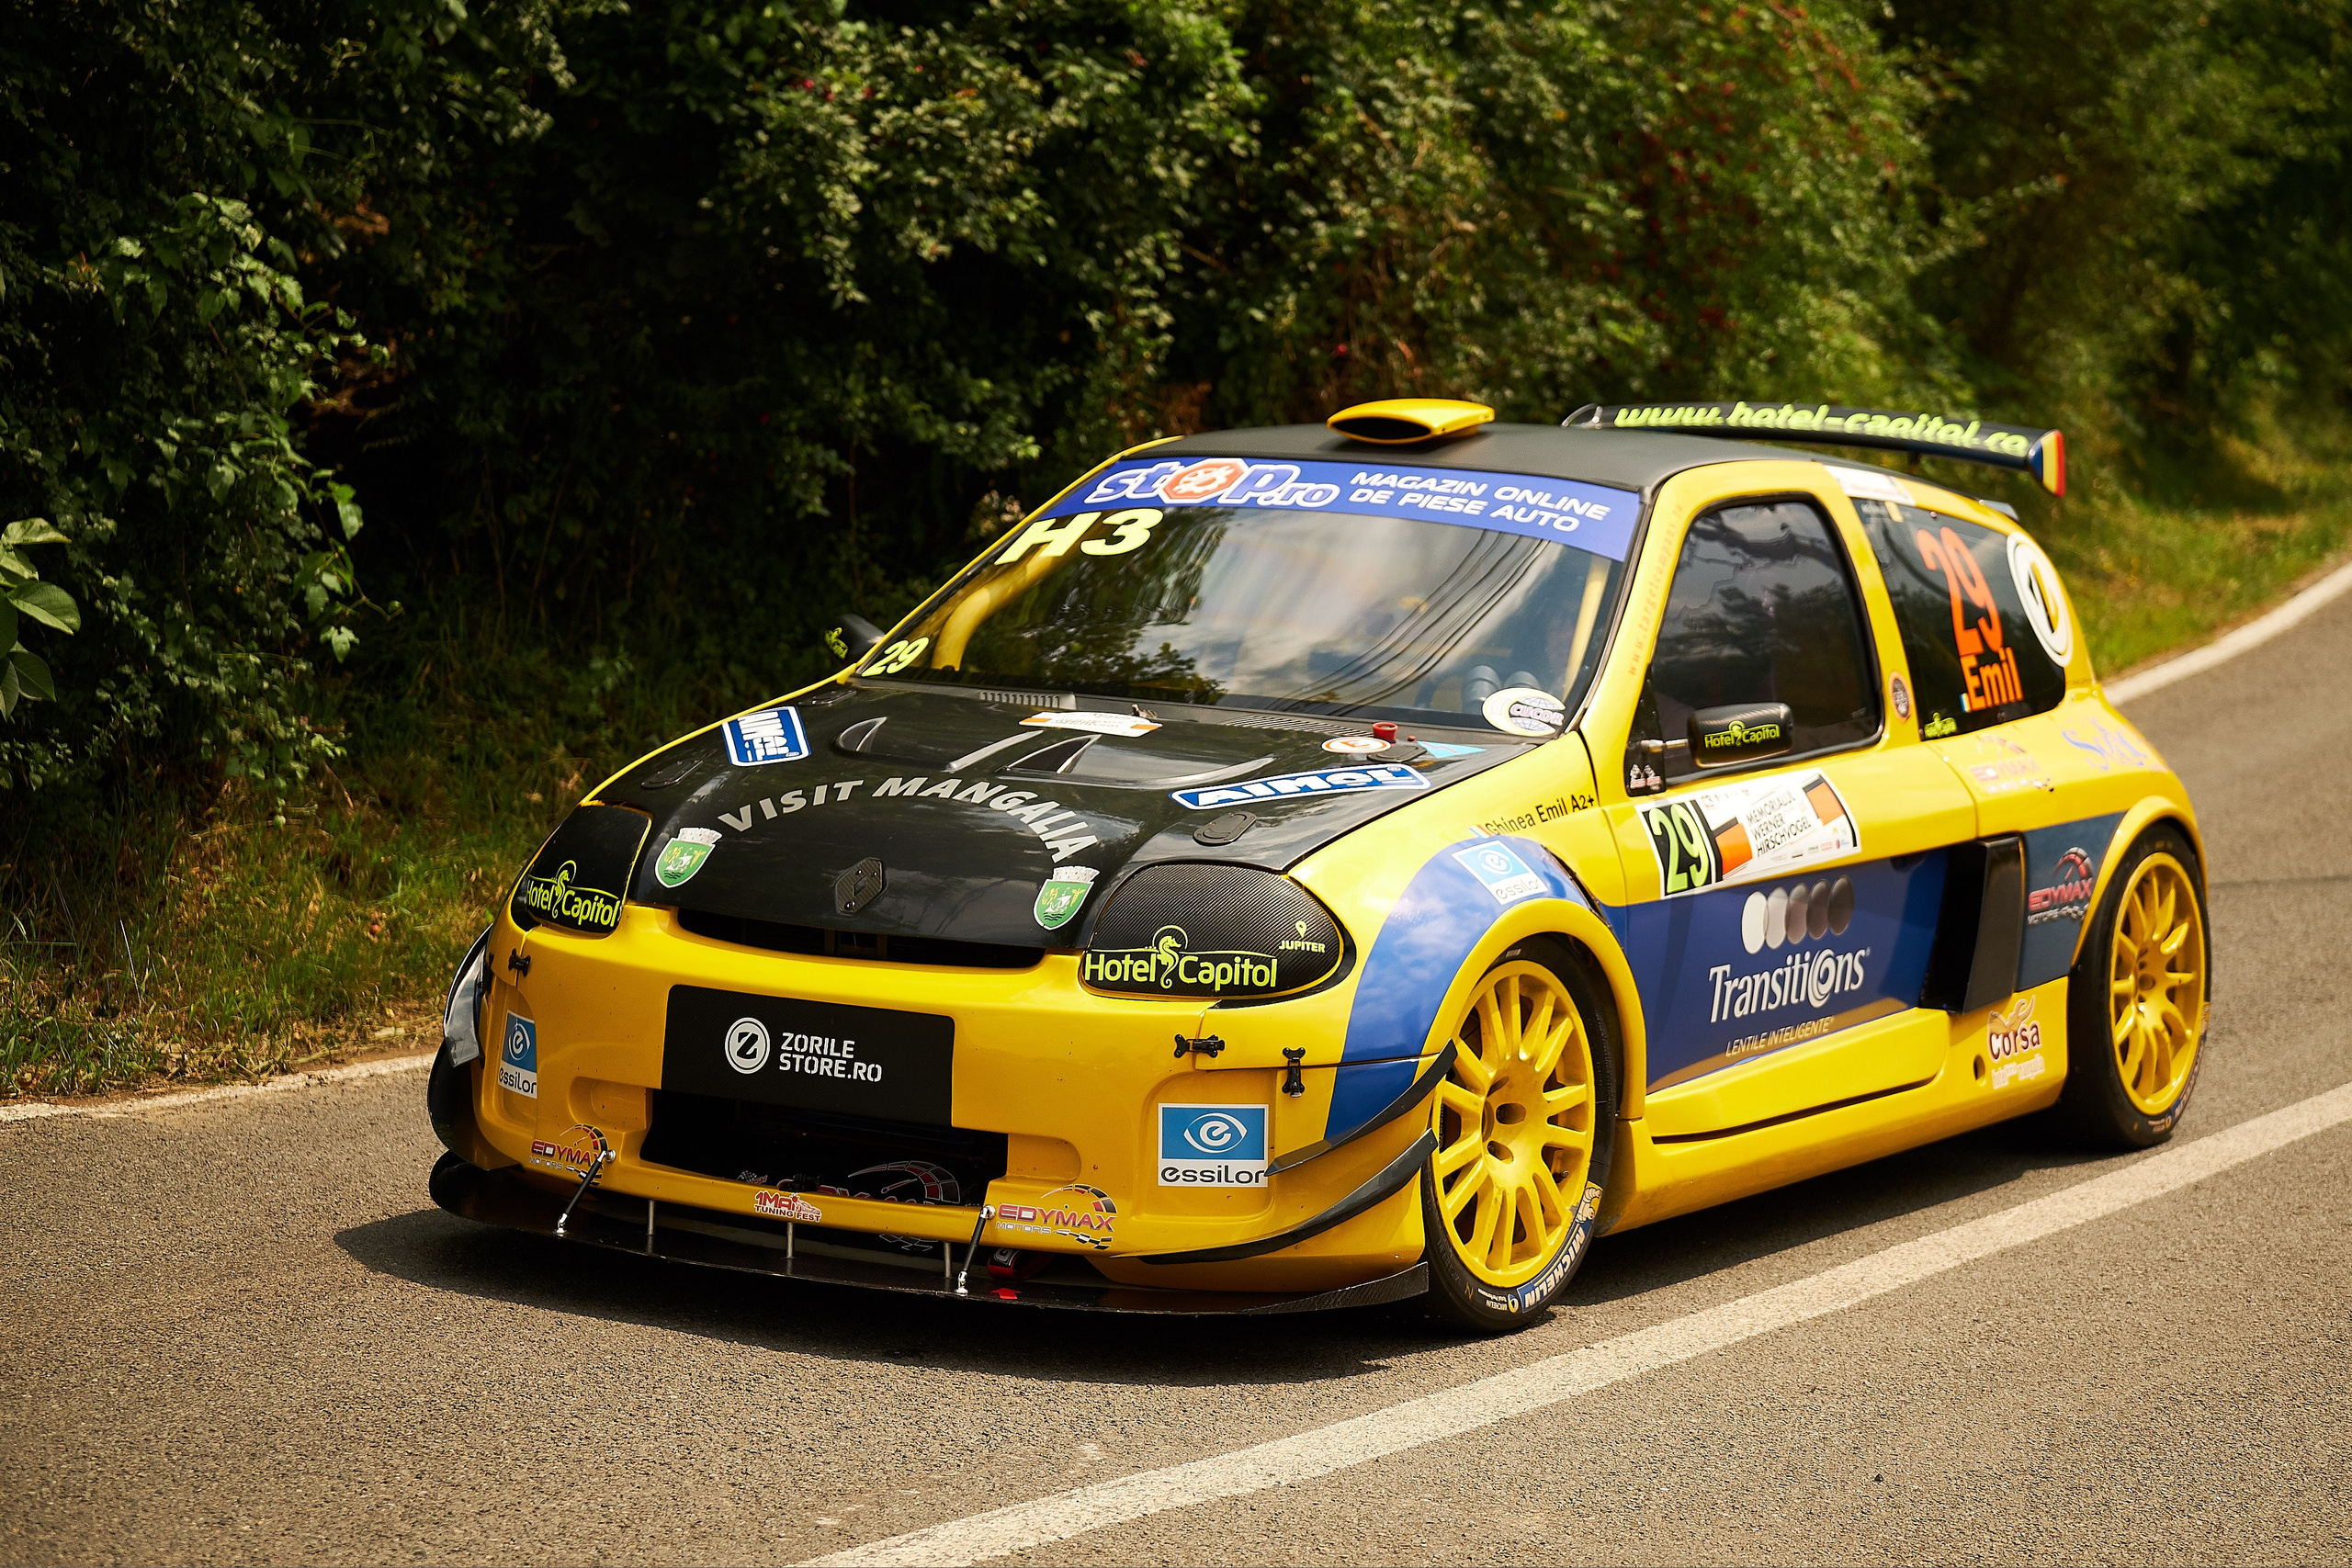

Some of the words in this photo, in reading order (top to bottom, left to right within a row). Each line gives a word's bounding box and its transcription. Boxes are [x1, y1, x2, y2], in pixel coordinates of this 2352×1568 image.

[1349, 488, 1395, 504] DE
[1397, 491, 1488, 515] PIESE
[1489, 504, 1580, 532] AUTO
[1350, 472, 1488, 497] MAGAZIN
[1493, 486, 1611, 521] ONLINE
[1917, 526, 2003, 655] 29
[861, 637, 929, 676] 29
[1960, 646, 2023, 712] Emil
[1510, 702, 1565, 727] CUCOR
[1704, 732, 1736, 749] Hotel
[1742, 726, 1781, 743] Capitol
[1198, 769, 1412, 807] AIMOL
[718, 780, 864, 832] VISIT
[872, 777, 1099, 863] MANGALIA
[1485, 812, 1536, 836] Ghinea
[1535, 796, 1568, 823] Emil
[1570, 794, 1595, 813] A2+
[1749, 812, 1786, 841] WERNER
[1648, 804, 1709, 894] 29
[1756, 816, 1812, 858] HIRSCHVOGEL
[526, 879, 556, 911] Hotel
[561, 890, 621, 927] Capitol
[2028, 877, 2094, 912] EDYMAX
[1278, 940, 1327, 953] JUPITER
[1085, 953, 1157, 982] Hotel
[1178, 955, 1278, 992] Capitol
[1708, 949, 1866, 1023] Transitions
[781, 1032, 855, 1059] ZORILE
[1725, 1032, 1769, 1056] LENTILE
[1767, 1016, 1832, 1046] INTELIGENTE
[498, 1066, 537, 1094] essilor
[779, 1053, 883, 1083] STORE.RO
[529, 1156, 564, 1170] MOTORS
[1160, 1165, 1265, 1185] essilor
[754, 1204, 794, 1217] TUNING
[796, 1212, 821, 1223] FEST
[995, 1221, 1052, 1235] MOTORS
[998, 1203, 1118, 1233] EDYMAX
[1524, 1226, 1587, 1308] MICHELIN
